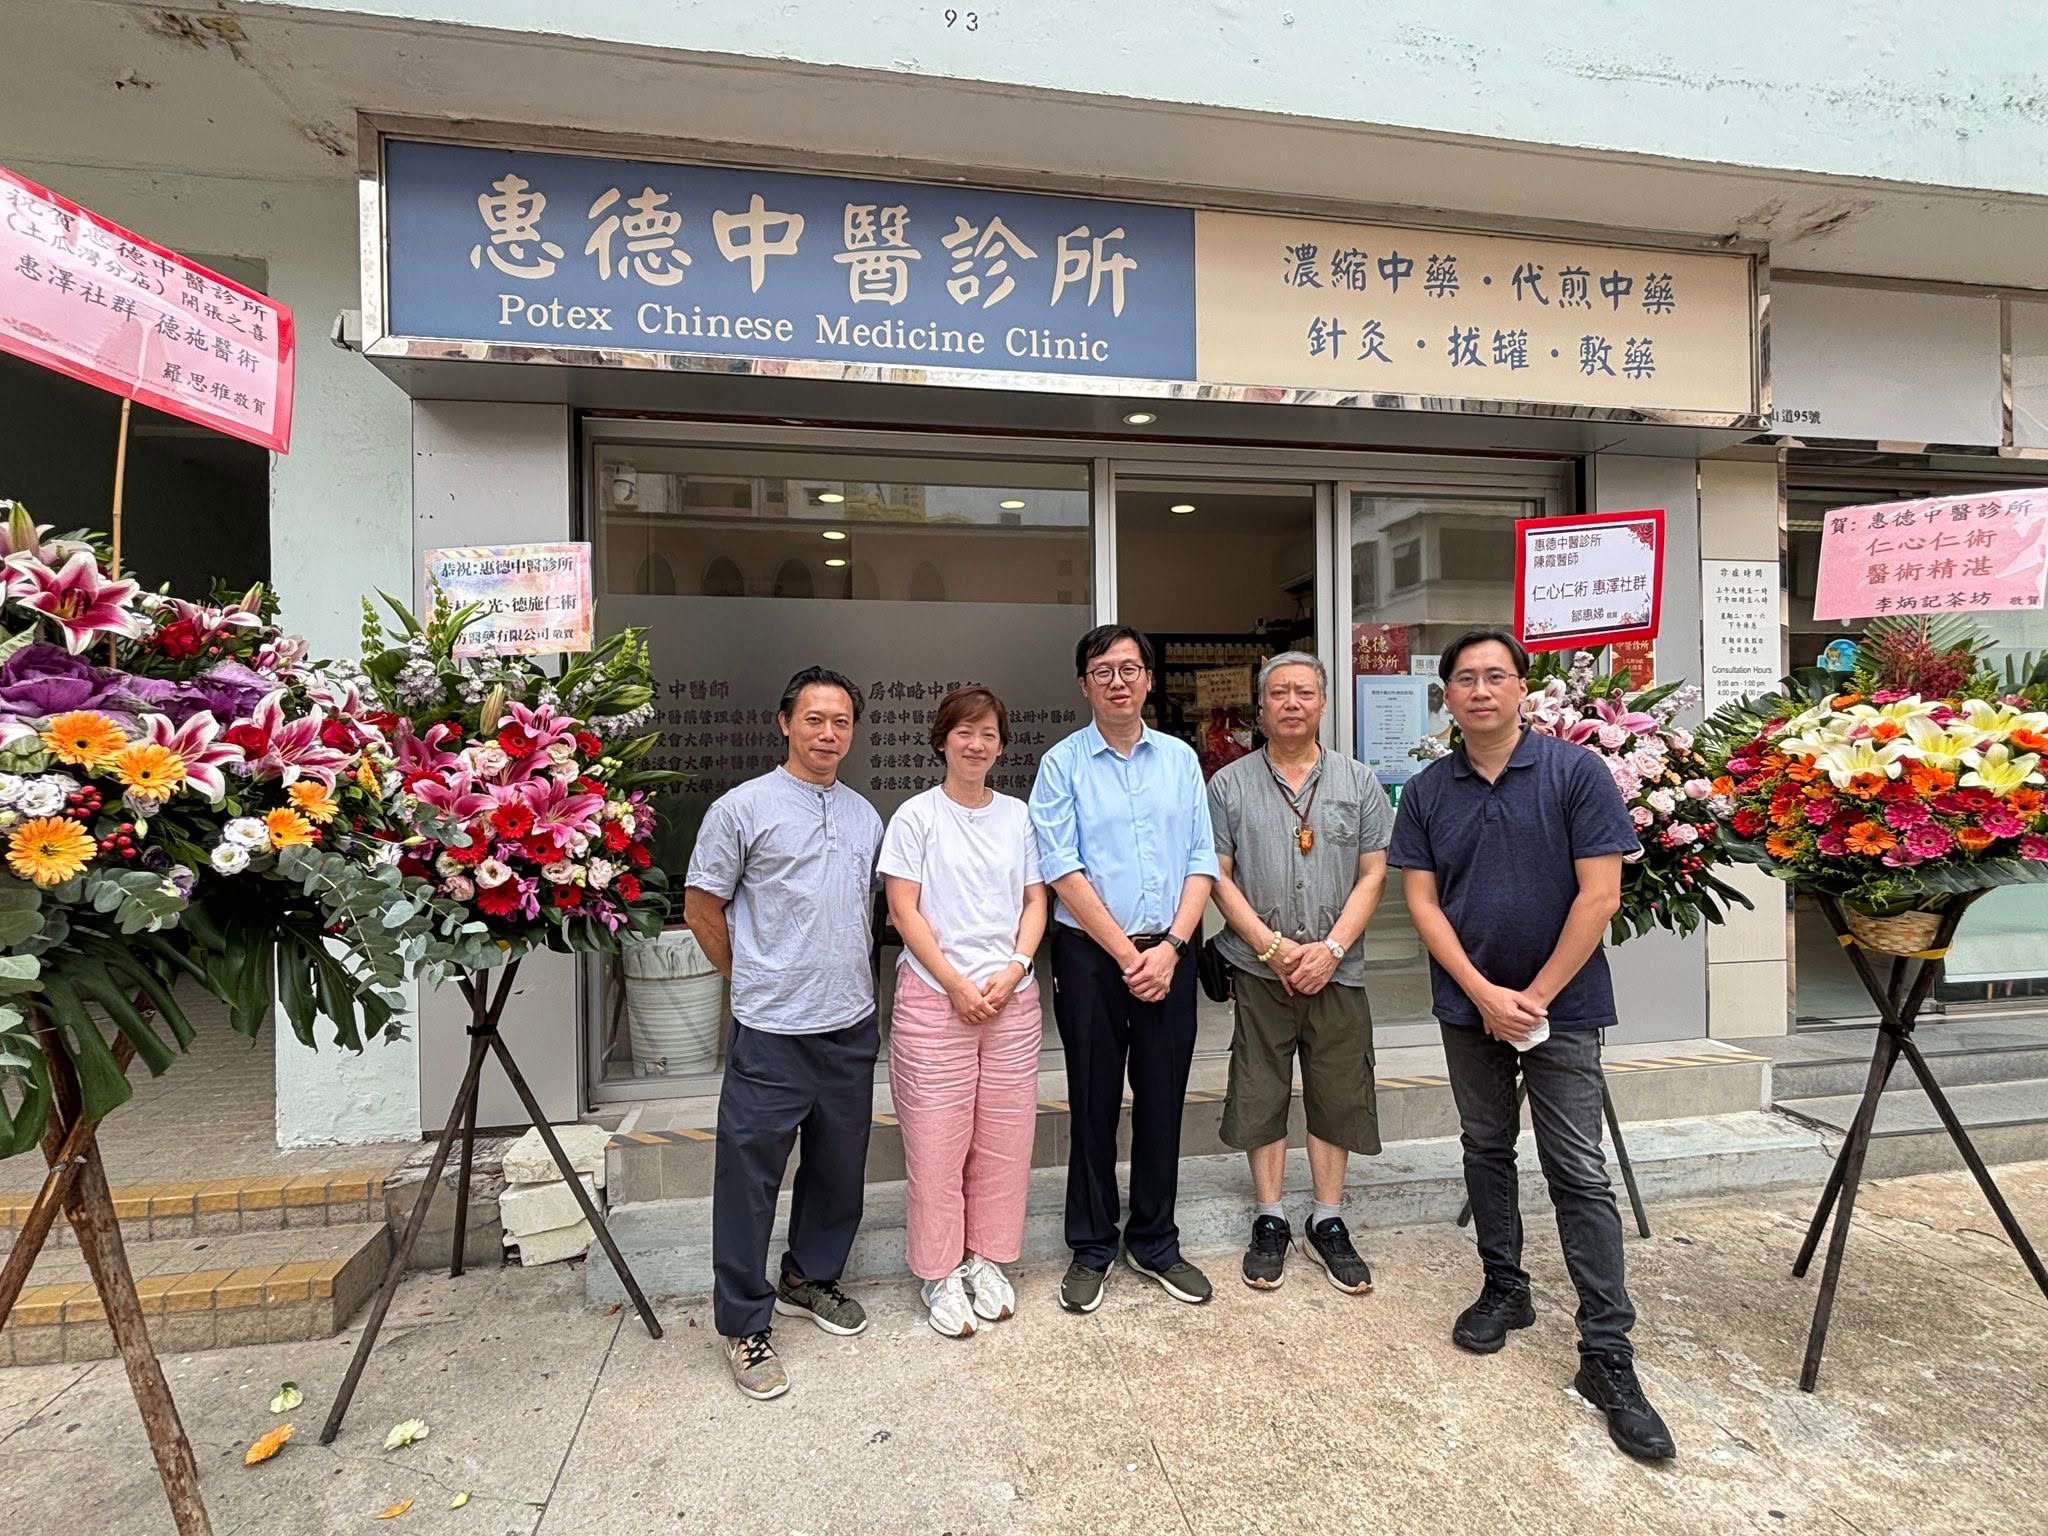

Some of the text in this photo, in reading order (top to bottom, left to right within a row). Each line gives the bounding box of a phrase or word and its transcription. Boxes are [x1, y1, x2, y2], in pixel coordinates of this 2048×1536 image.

[469, 173, 1138, 319] 惠德中醫診所
[14, 253, 260, 374] 惠澤社群 德施醫術
[181, 291, 268, 342] 開張之喜
[498, 294, 1109, 362] Potex Chinese Medicine Clinic
[1534, 534, 1602, 552] 惠德中醫診所
[1865, 528, 1998, 557] 仁心仁術
[1534, 552, 1579, 569] 陳霞醫師
[1866, 556, 1993, 585] 醫術精湛
[1532, 574, 1647, 602] 仁心仁術 惠澤社群
[448, 594, 577, 613] 之光、德施仁術
[1875, 591, 1992, 613] 李炳記茶坊
[1357, 634, 1388, 653] 惠德
[1712, 665, 1773, 675] Consultation Hours
[869, 680, 981, 700] 房偉略中
